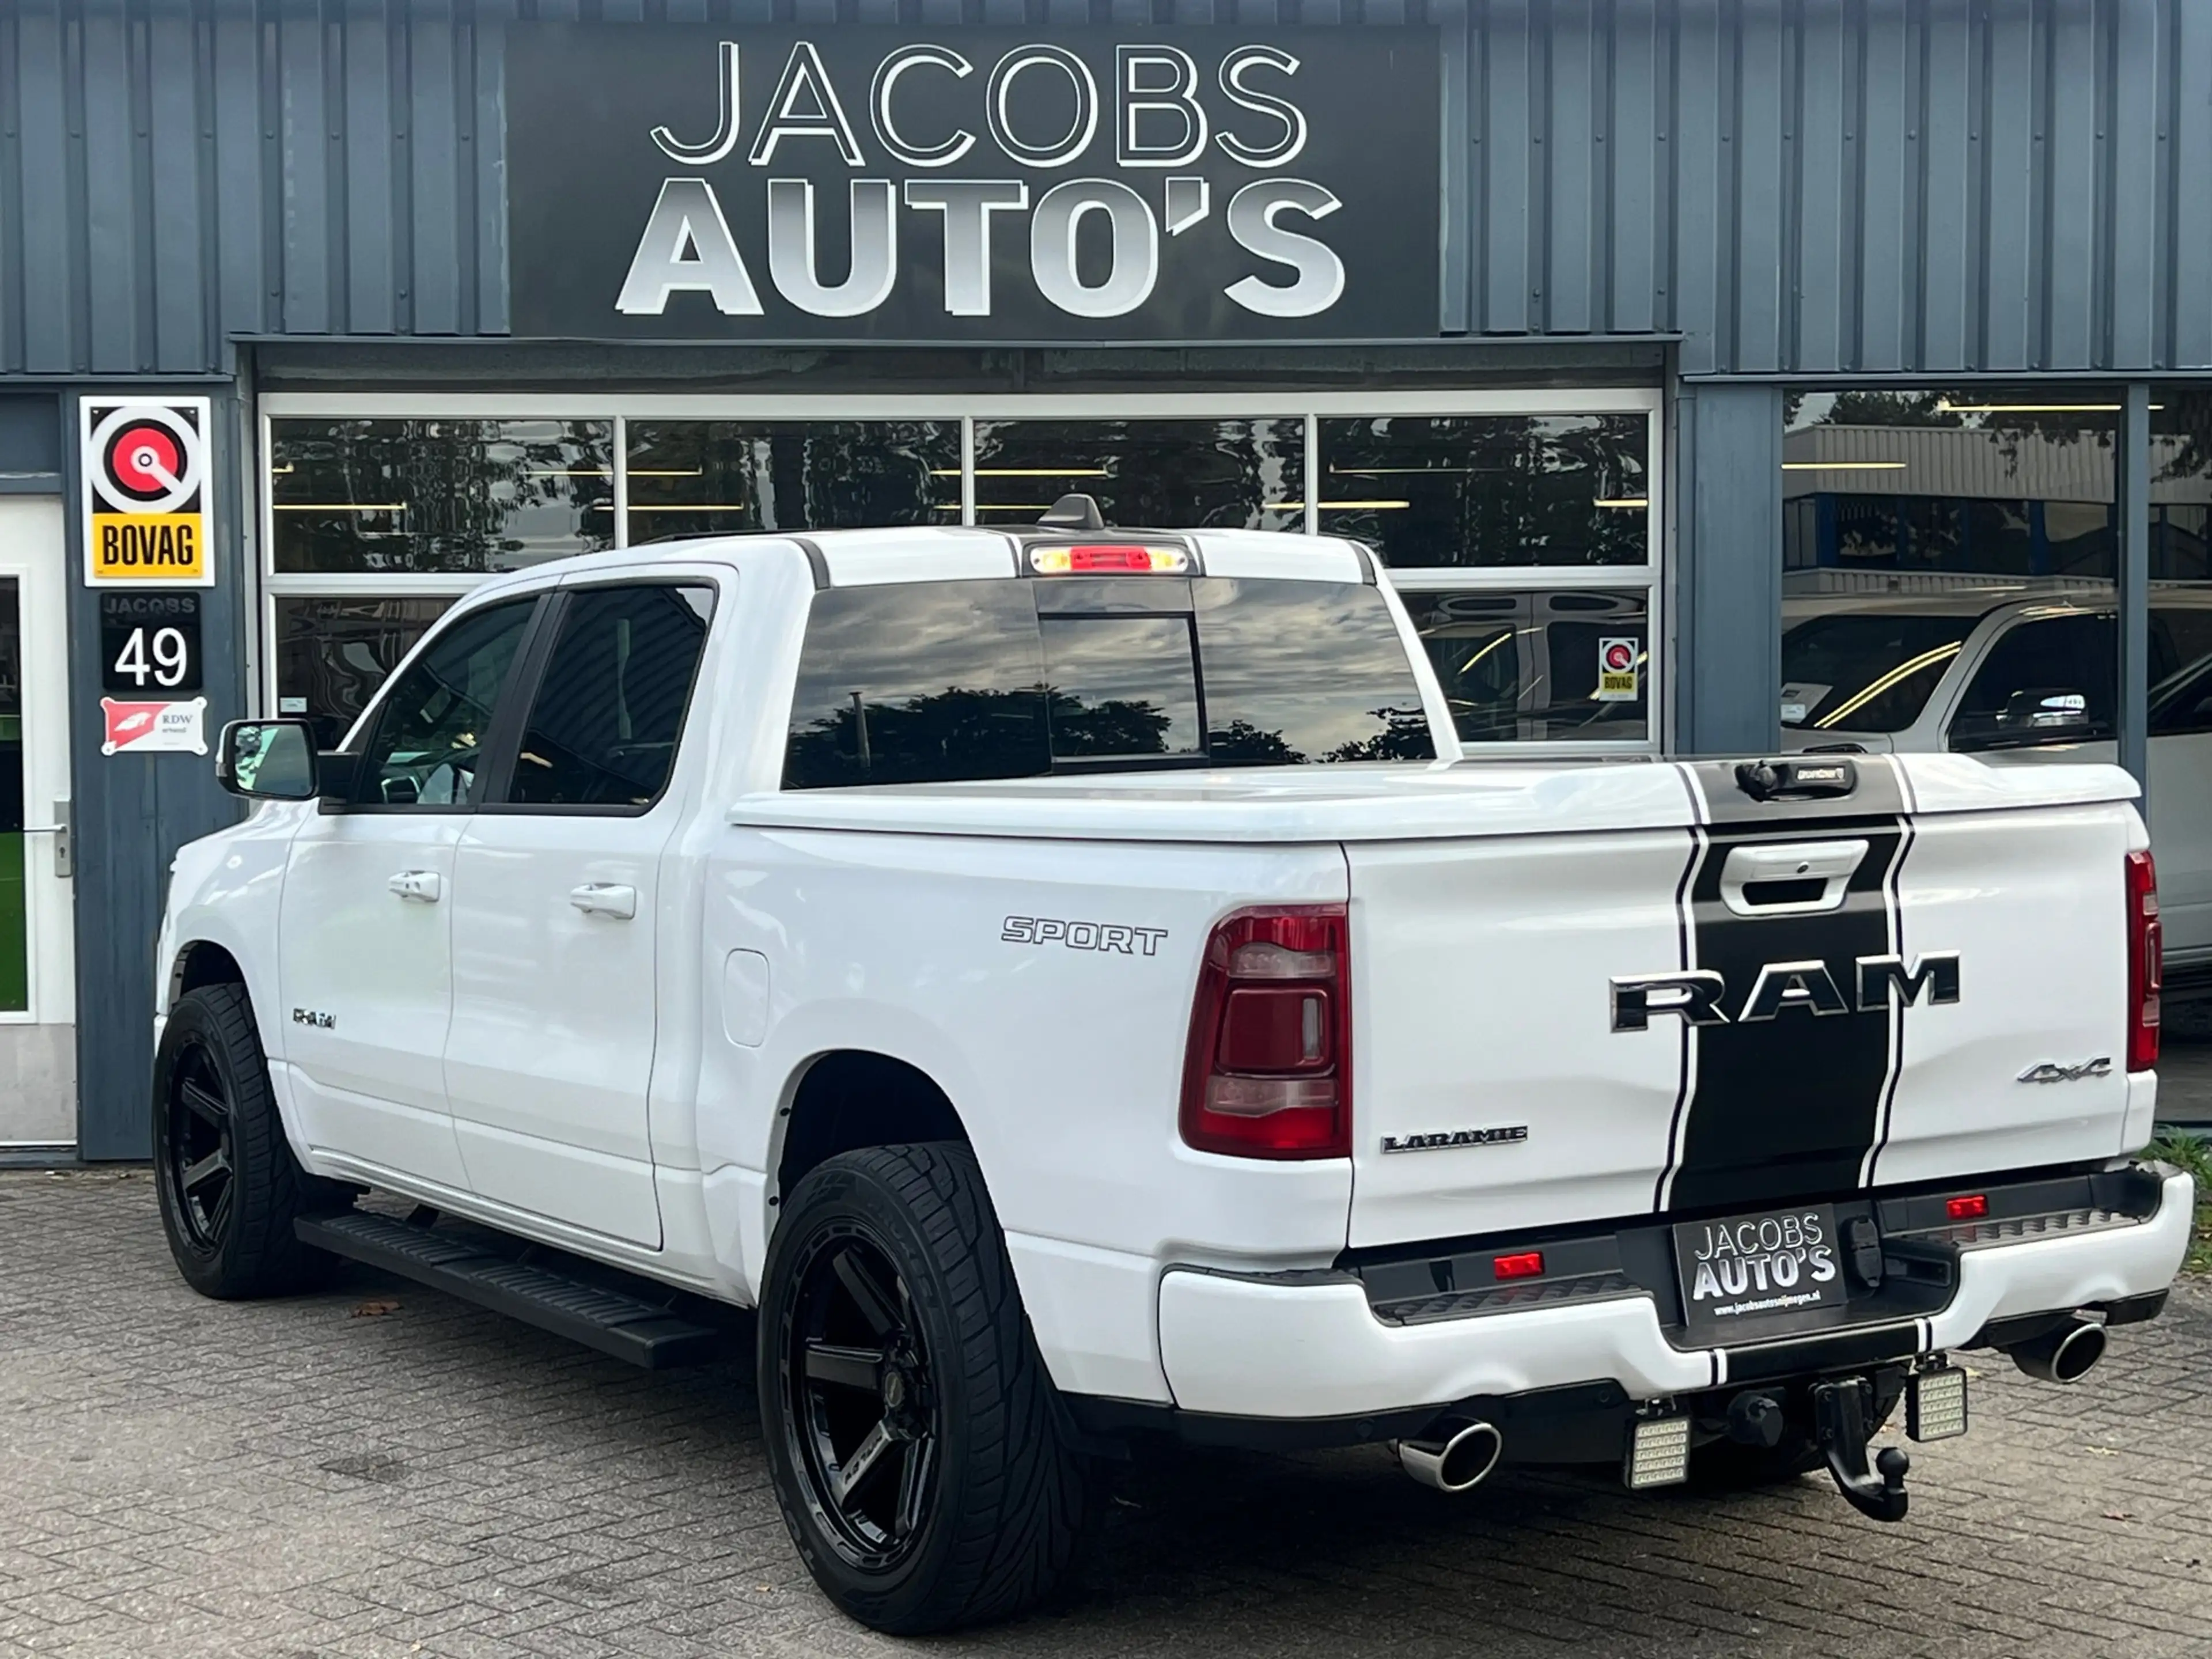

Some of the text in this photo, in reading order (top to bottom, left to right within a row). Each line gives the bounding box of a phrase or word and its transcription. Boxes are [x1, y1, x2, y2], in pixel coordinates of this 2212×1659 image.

[650, 40, 1308, 168] JACOBS
[615, 176, 1345, 318] AUTO'S
[102, 524, 194, 566] BOVAG
[104, 597, 195, 614] JACOBS
[114, 626, 187, 687] 49
[1604, 676, 1633, 690] BOVAG
[162, 714, 194, 724] RDW
[1001, 915, 1169, 956] SPORT
[1608, 949, 1961, 1034] RAM
[1381, 1124, 1528, 1154] LARAMIE
[1694, 1212, 1823, 1261] JACOBS
[1692, 1244, 1836, 1301] AUTO'S
